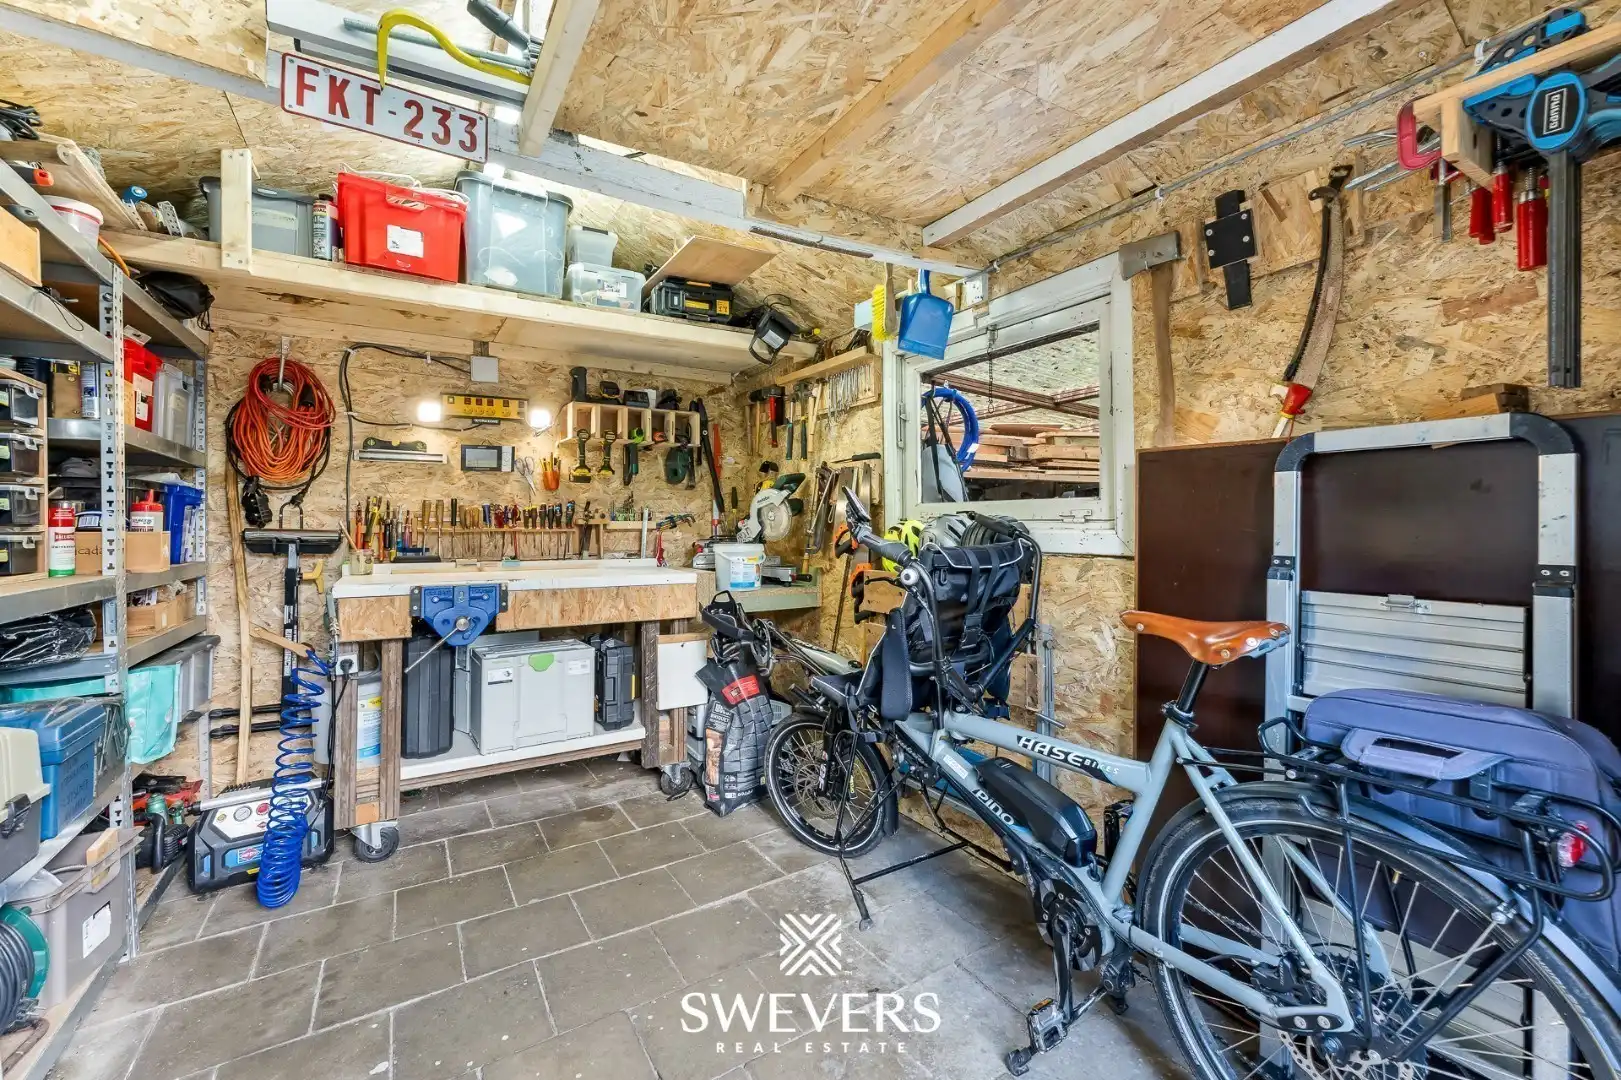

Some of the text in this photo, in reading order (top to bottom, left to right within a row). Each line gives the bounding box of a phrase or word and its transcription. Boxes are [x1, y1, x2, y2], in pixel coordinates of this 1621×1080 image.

[296, 65, 477, 152] FKT-233
[1018, 735, 1120, 775] HASE BIKES
[975, 790, 1015, 825] PINO
